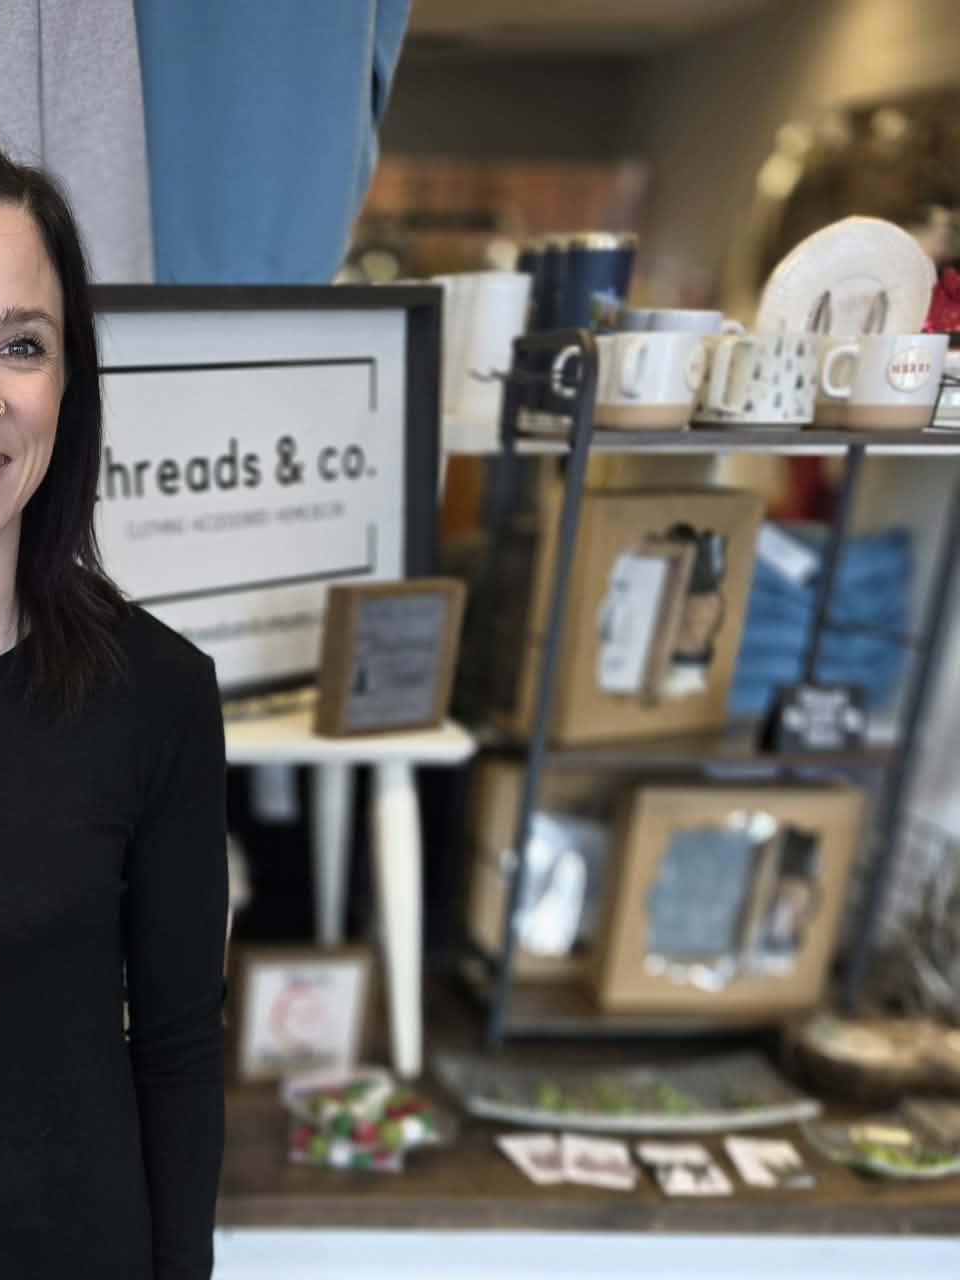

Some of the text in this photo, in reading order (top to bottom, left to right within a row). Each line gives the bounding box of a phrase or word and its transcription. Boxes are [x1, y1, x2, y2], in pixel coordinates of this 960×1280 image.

[103, 433, 378, 500] hreads & co.
